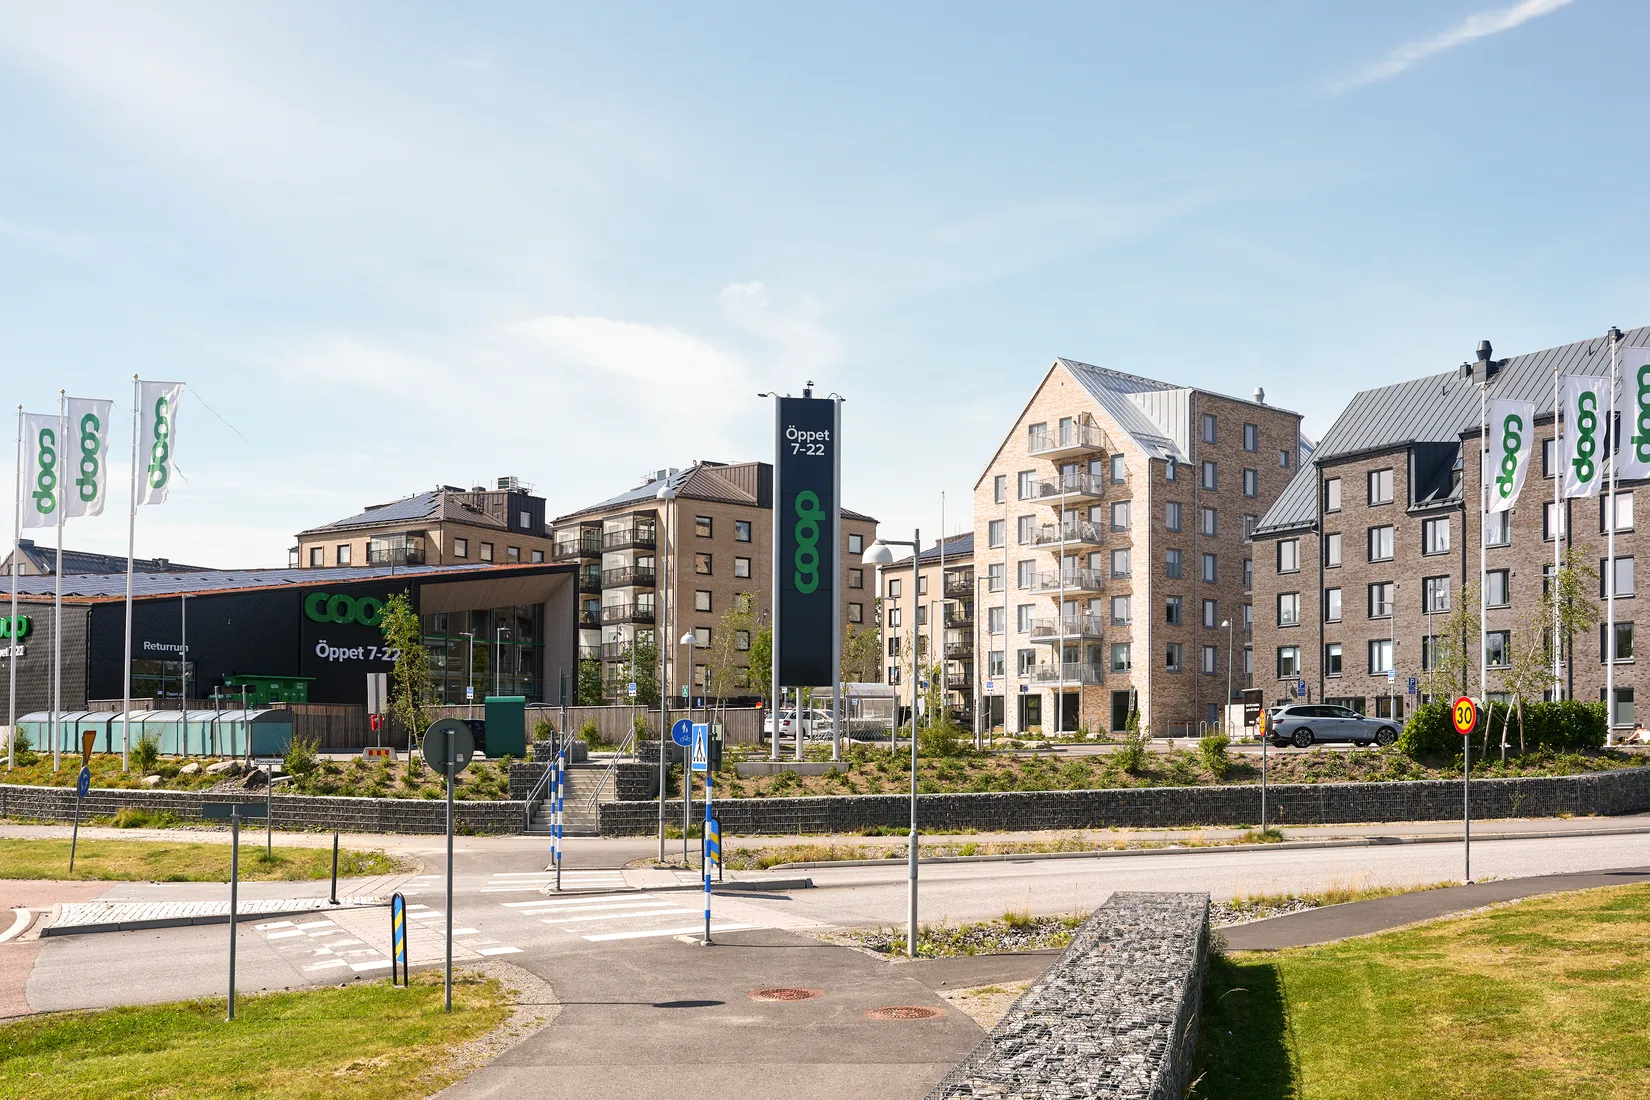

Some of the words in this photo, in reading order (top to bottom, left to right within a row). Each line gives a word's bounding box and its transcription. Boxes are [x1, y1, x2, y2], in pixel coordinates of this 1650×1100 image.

[32, 428, 57, 514] coop
[75, 412, 100, 502] coop
[148, 396, 169, 489] coop
[785, 425, 830, 443] Öppet
[791, 443, 825, 456] 7-22
[1495, 413, 1523, 499] coop
[1571, 391, 1597, 483] coop
[794, 490, 826, 594] coop
[143, 641, 189, 652] Returrum
[315, 639, 364, 662] Öppet
[366, 645, 401, 661] 7-22
[1456, 706, 1473, 725] 30
